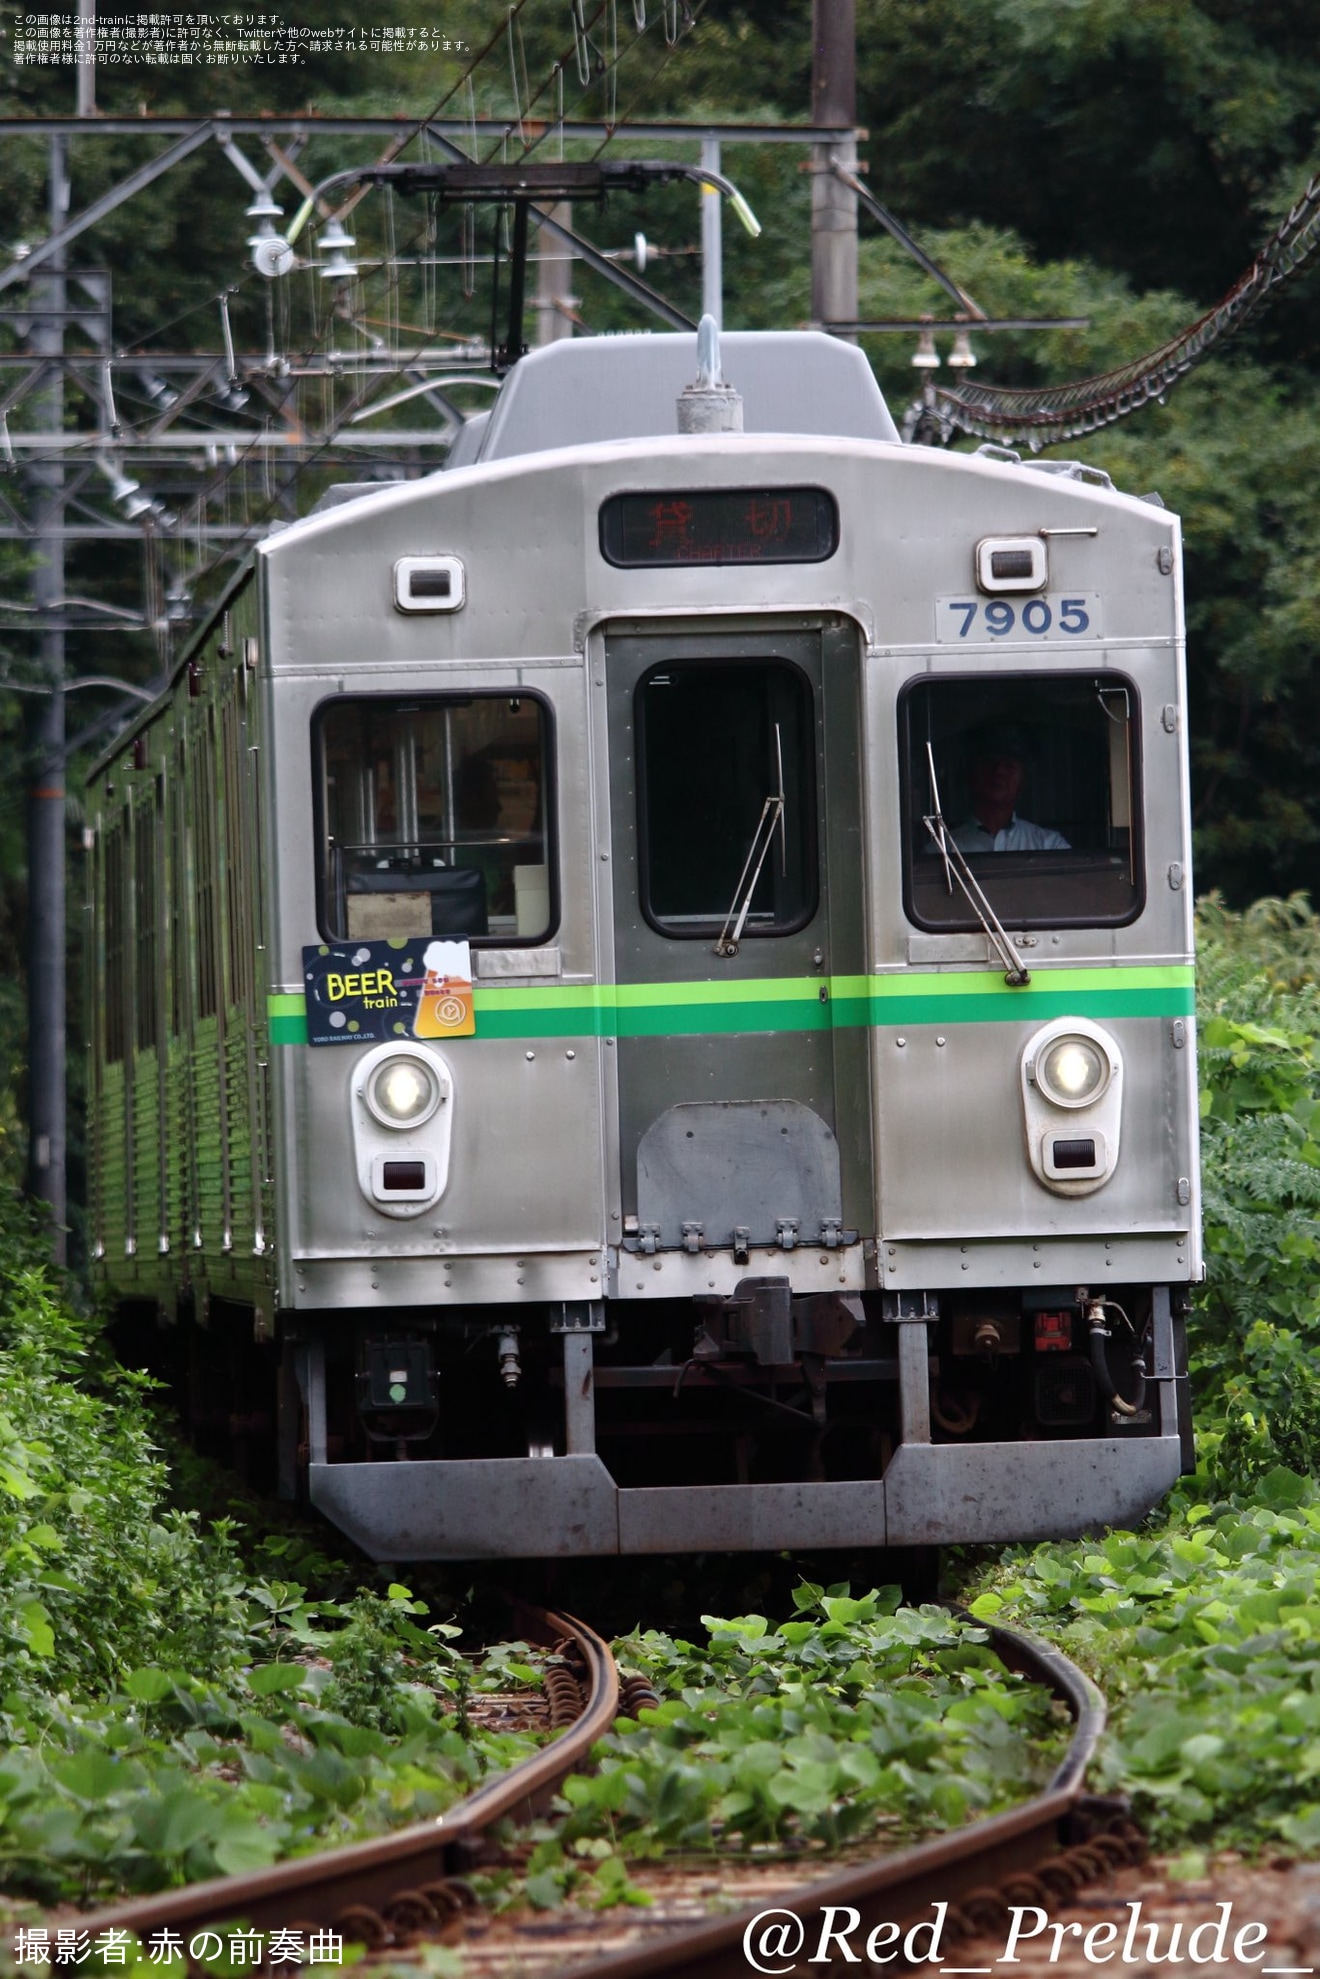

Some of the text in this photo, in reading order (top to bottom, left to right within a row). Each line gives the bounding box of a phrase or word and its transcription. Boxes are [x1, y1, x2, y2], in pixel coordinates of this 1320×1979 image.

[949, 599, 1090, 638] 7905
[327, 969, 398, 1002] BEER
[363, 996, 398, 1010] train
